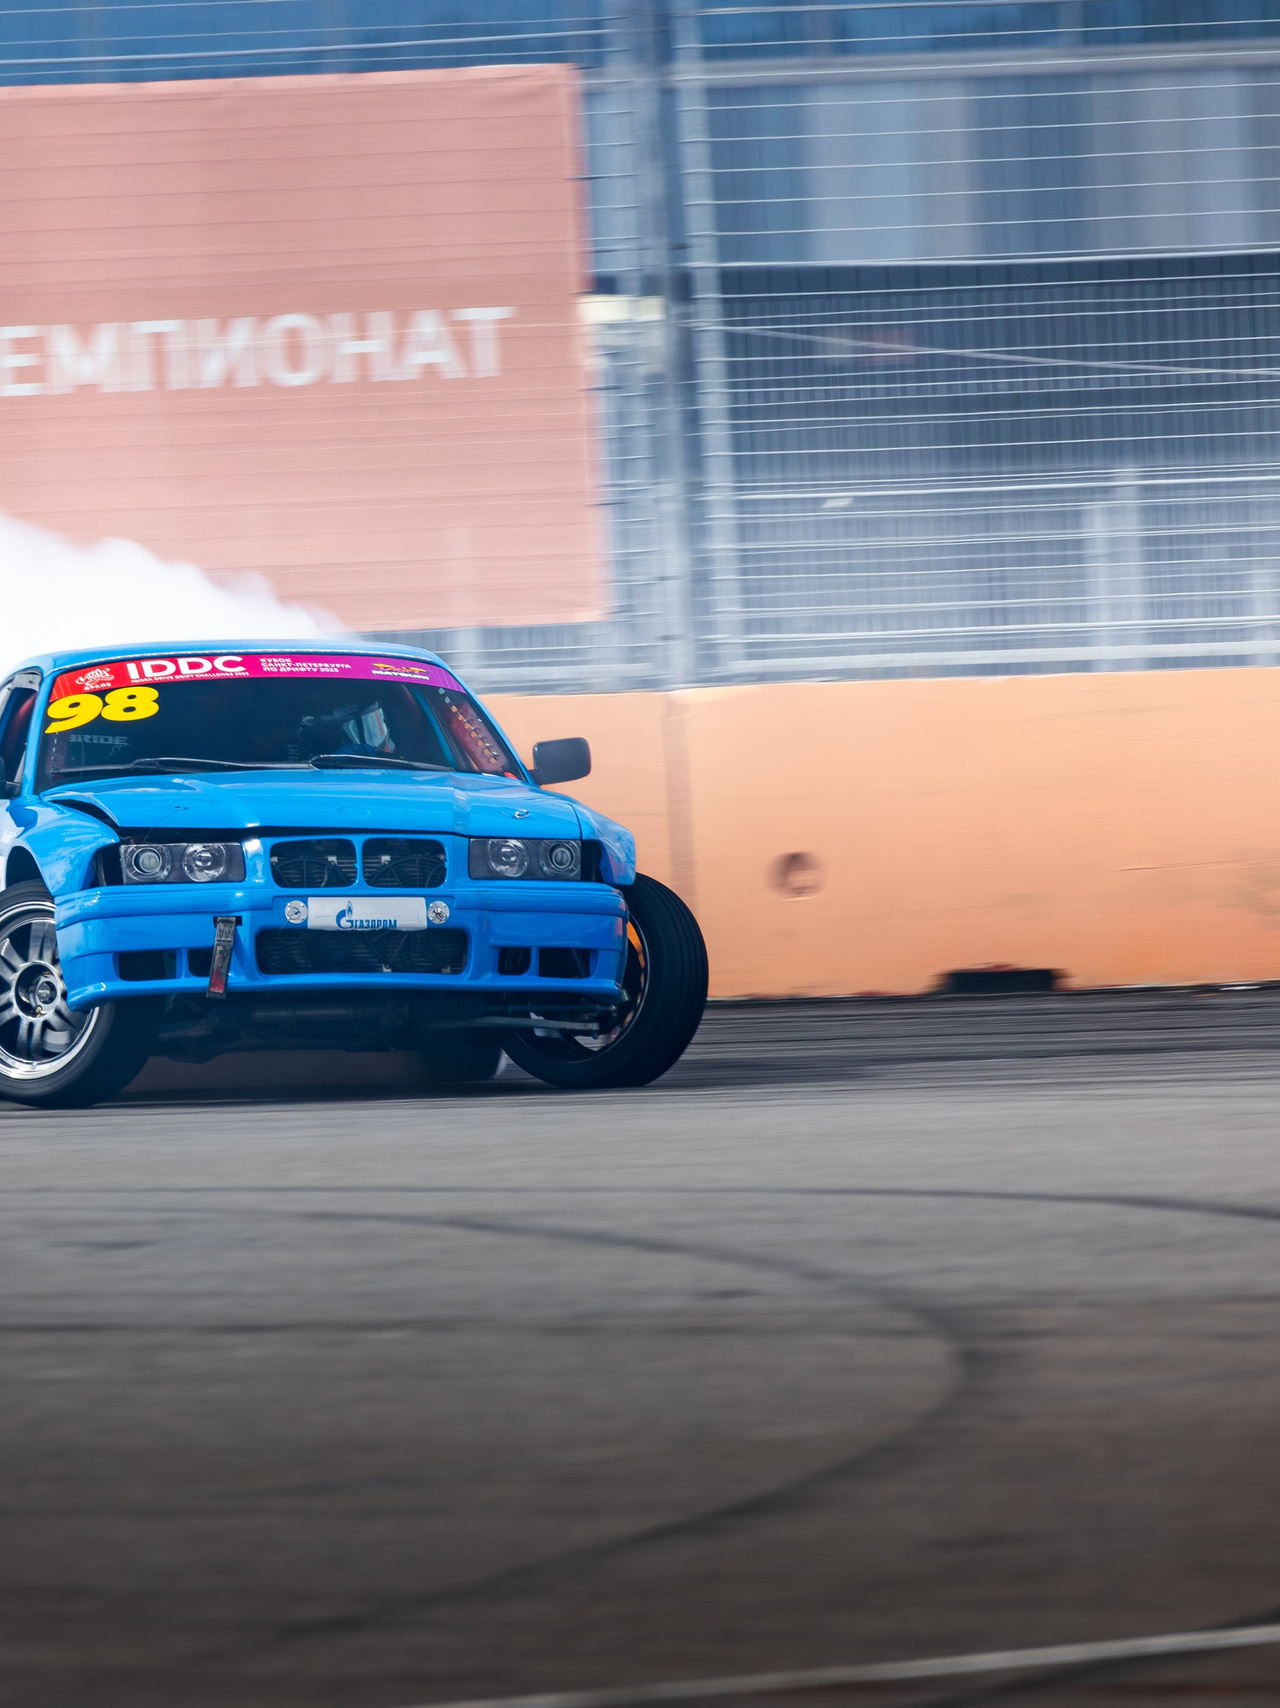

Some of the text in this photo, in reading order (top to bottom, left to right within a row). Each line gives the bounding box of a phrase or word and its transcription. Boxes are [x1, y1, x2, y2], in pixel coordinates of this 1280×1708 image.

[126, 655, 247, 680] IDDC
[44, 686, 159, 734] 98
[354, 919, 398, 930] ГАЗПРОМ
